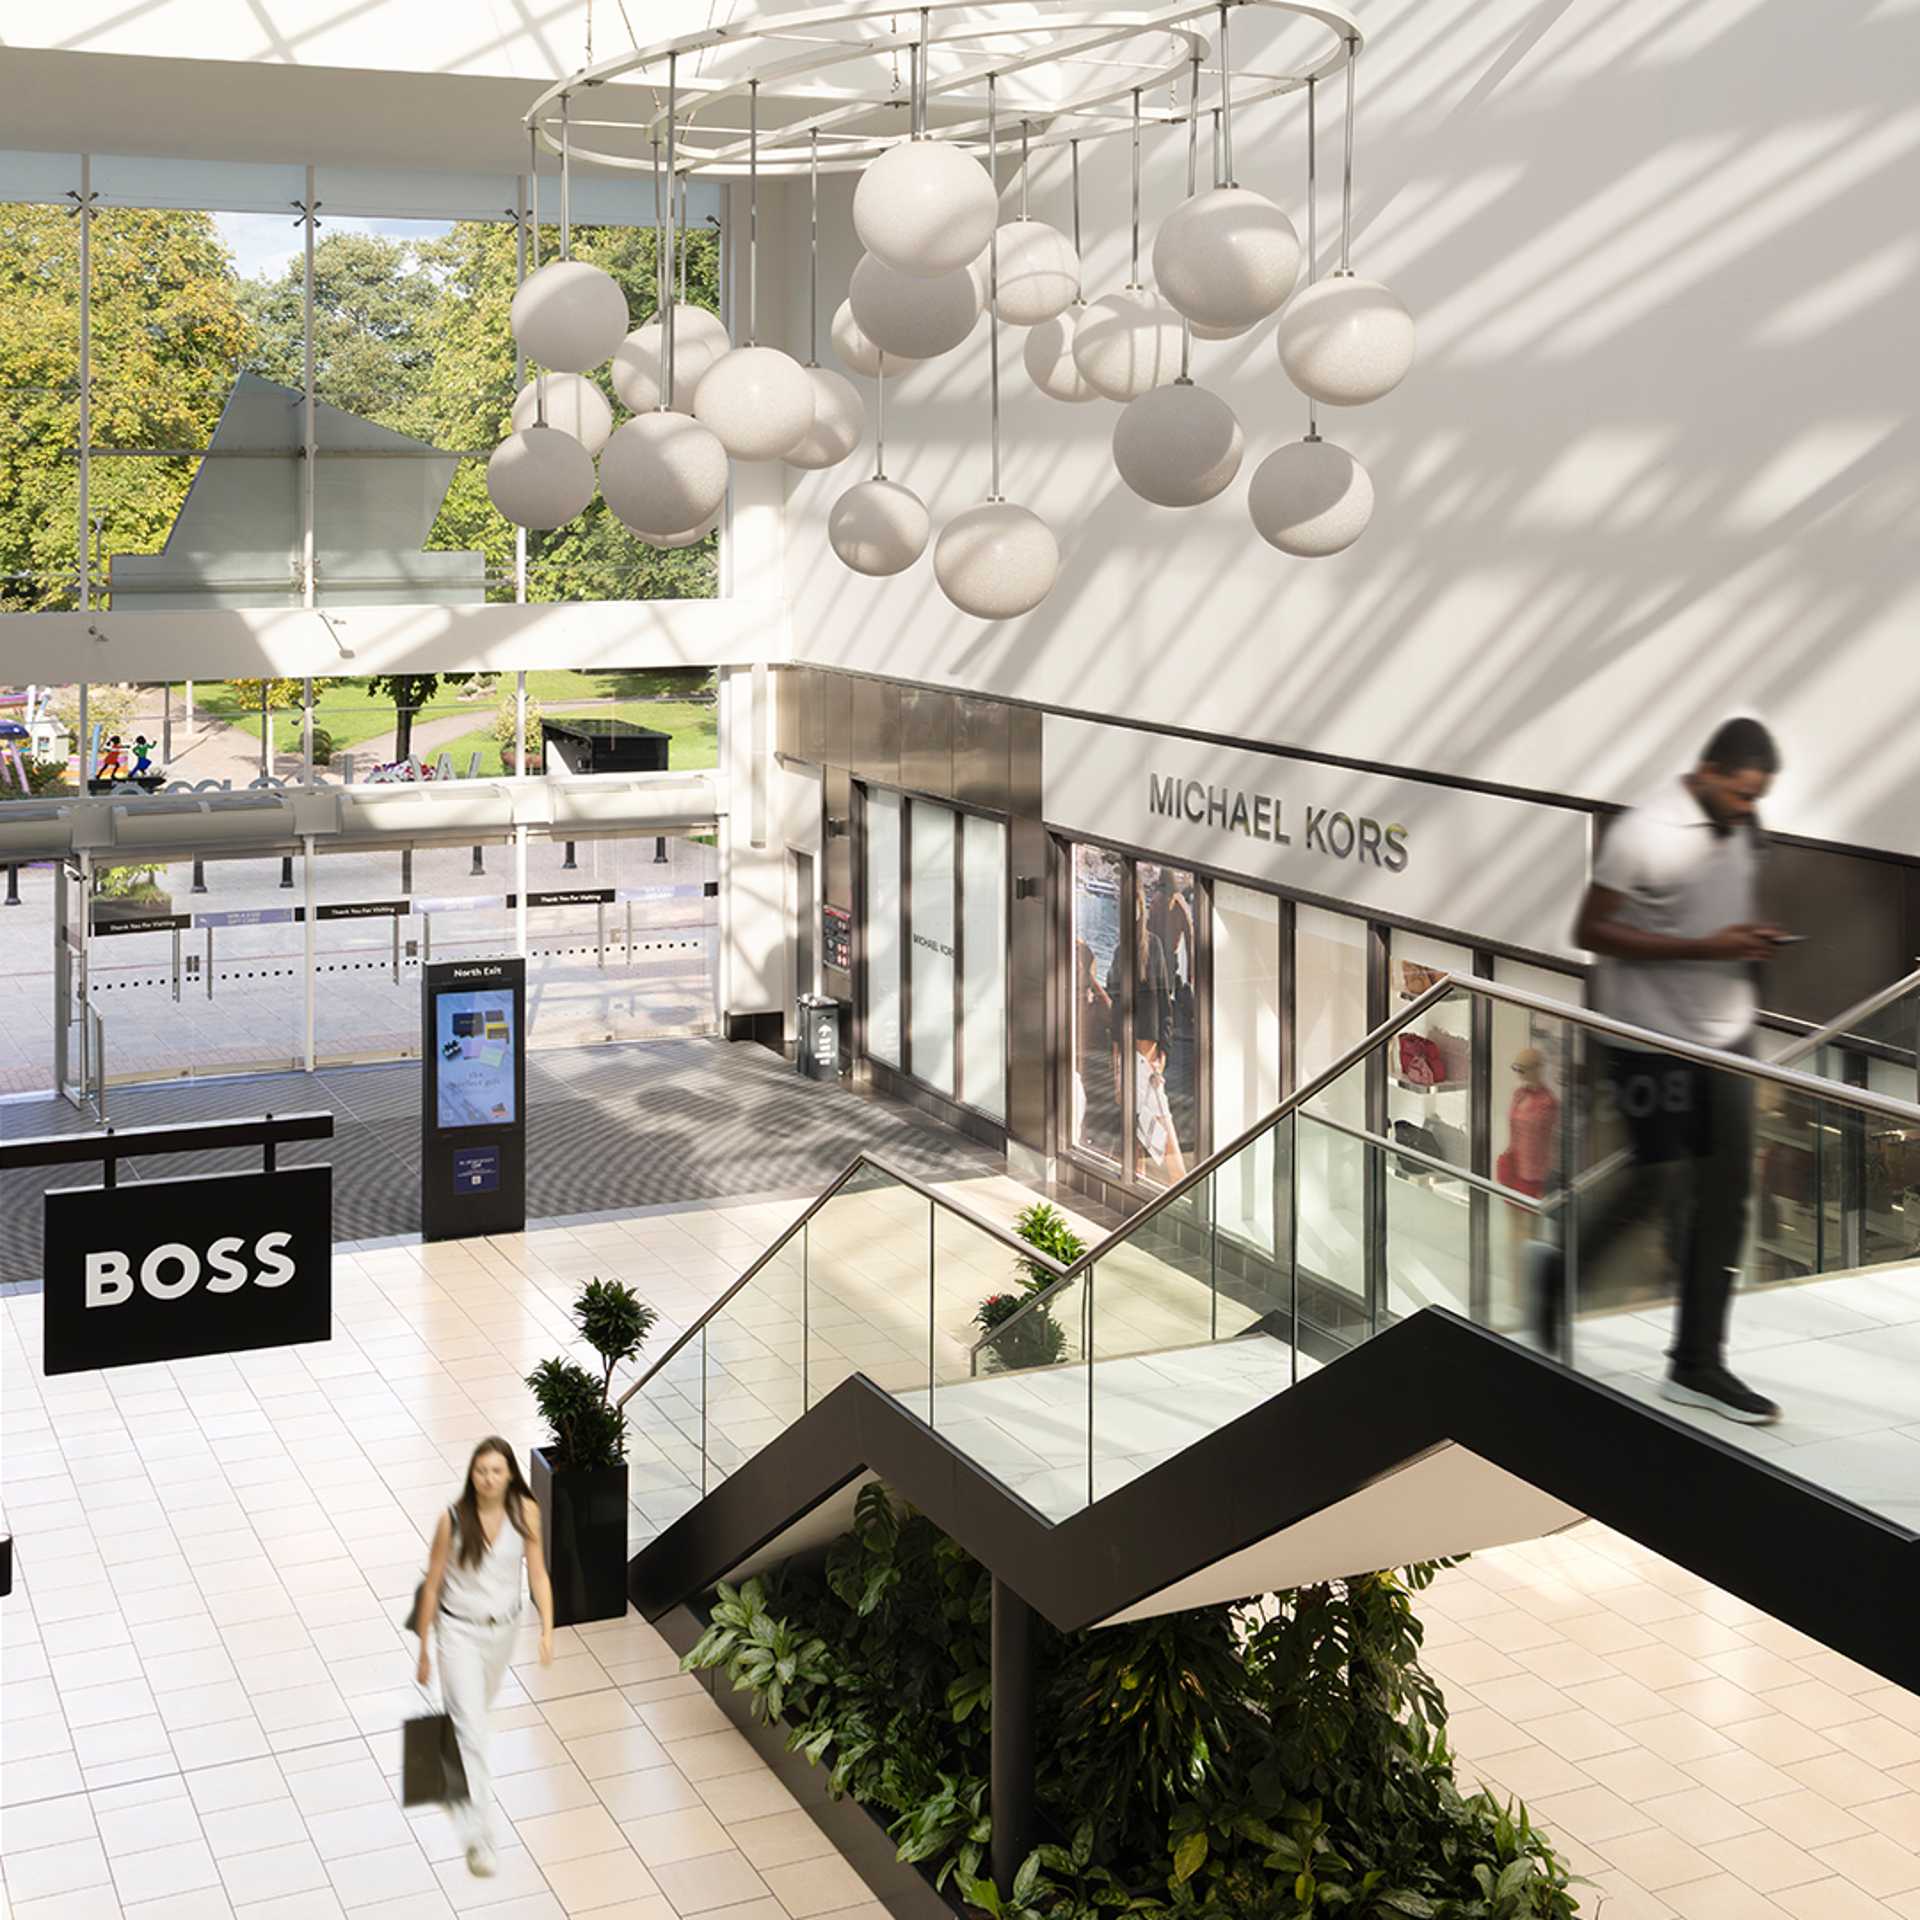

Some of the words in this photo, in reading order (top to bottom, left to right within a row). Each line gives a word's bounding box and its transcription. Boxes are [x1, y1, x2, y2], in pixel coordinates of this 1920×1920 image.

[1150, 773, 1291, 845] MICHAEL
[1306, 805, 1409, 874] KORS
[453, 966, 482, 978] North
[484, 965, 503, 976] Exit
[85, 1231, 296, 1308] BOSS
